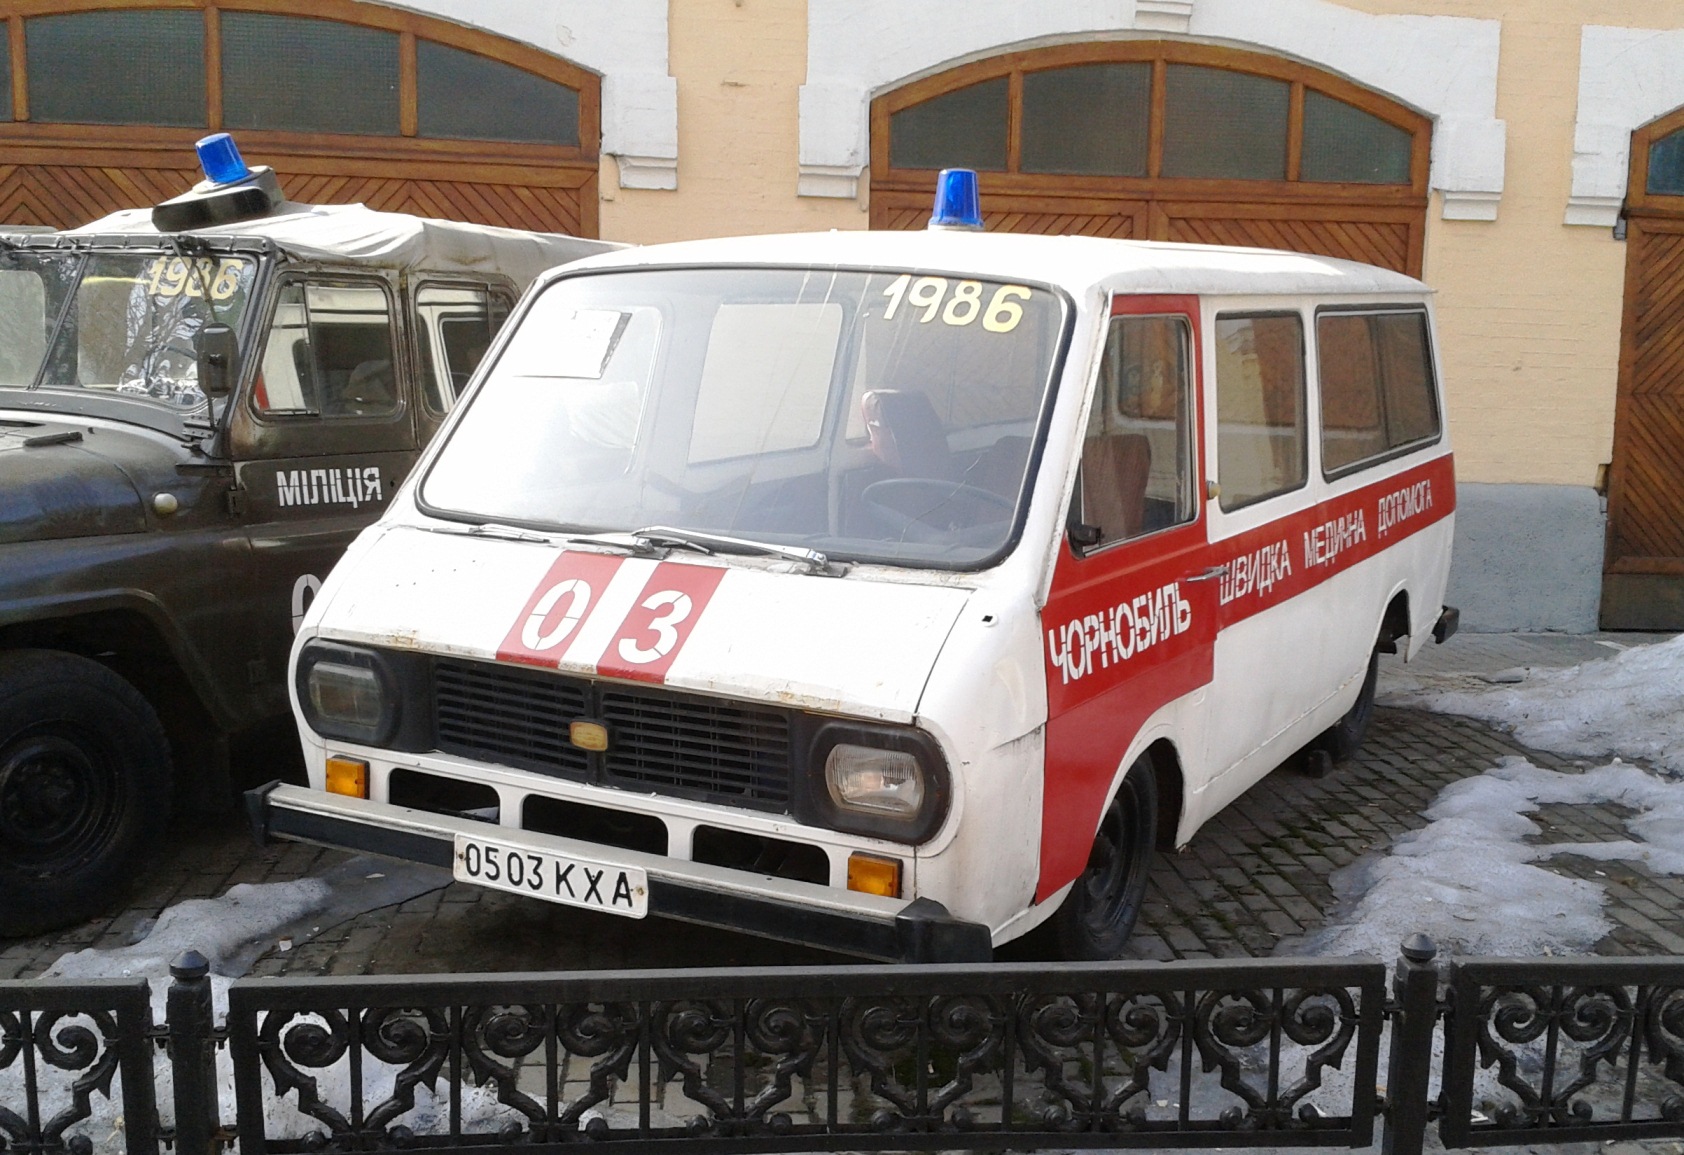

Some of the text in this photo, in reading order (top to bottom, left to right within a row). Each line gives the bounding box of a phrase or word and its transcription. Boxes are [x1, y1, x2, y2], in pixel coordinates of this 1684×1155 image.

[148, 255, 243, 300] 1986
[882, 274, 1032, 333] 1986
[276, 466, 383, 509] МІЛІЦІЯ
[1048, 479, 1433, 685] ЧОРНОБИЛЬ ШВИДКА МЕДИЧНА ДОПОМОГА
